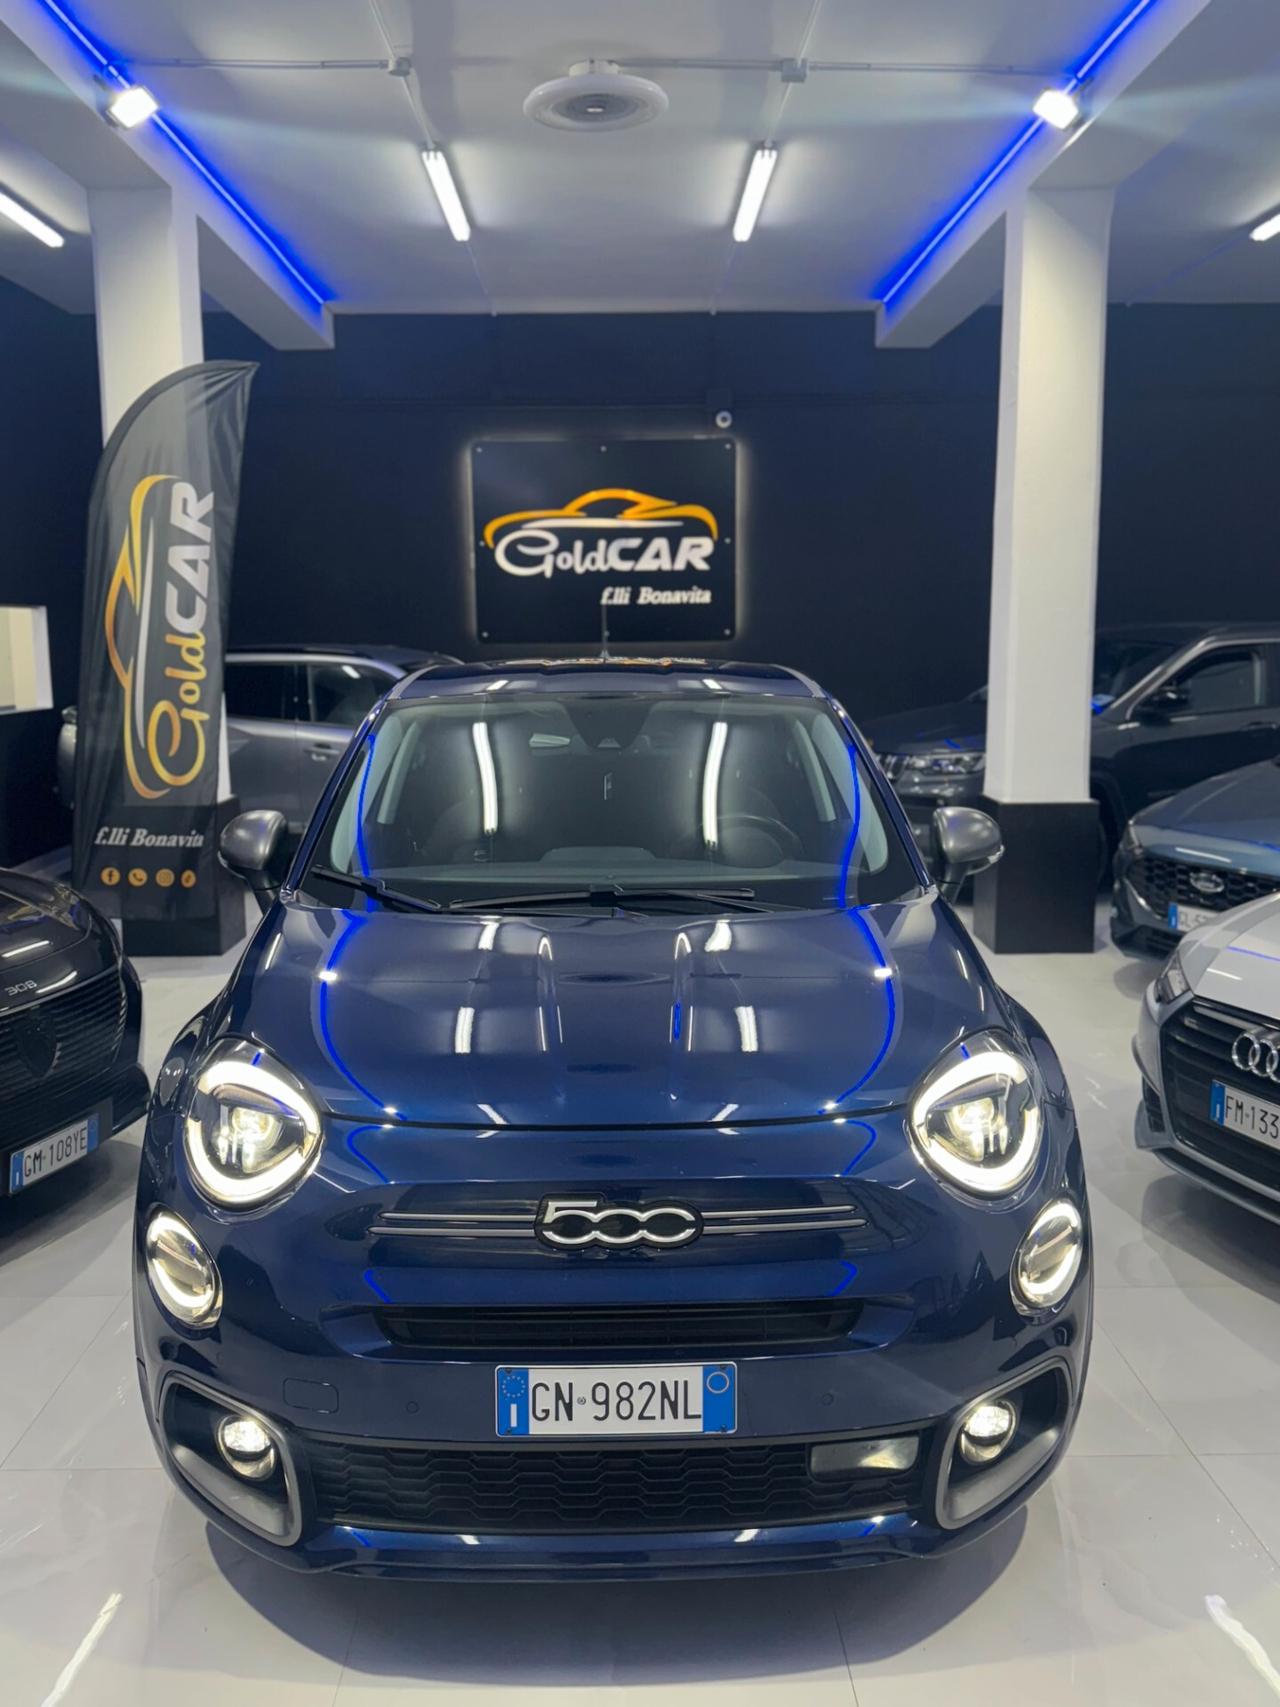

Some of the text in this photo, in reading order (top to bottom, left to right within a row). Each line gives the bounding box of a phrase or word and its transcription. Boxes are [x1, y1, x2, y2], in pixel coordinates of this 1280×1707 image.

[494, 529, 715, 578] GoldCAR
[636, 585, 712, 605] Bonavita
[147, 481, 215, 787] GoldCAR
[129, 827, 204, 848] Bonavita
[4, 980, 38, 996] 308
[542, 1200, 697, 1244] 500
[531, 1379, 703, 1422] GN 982NL
